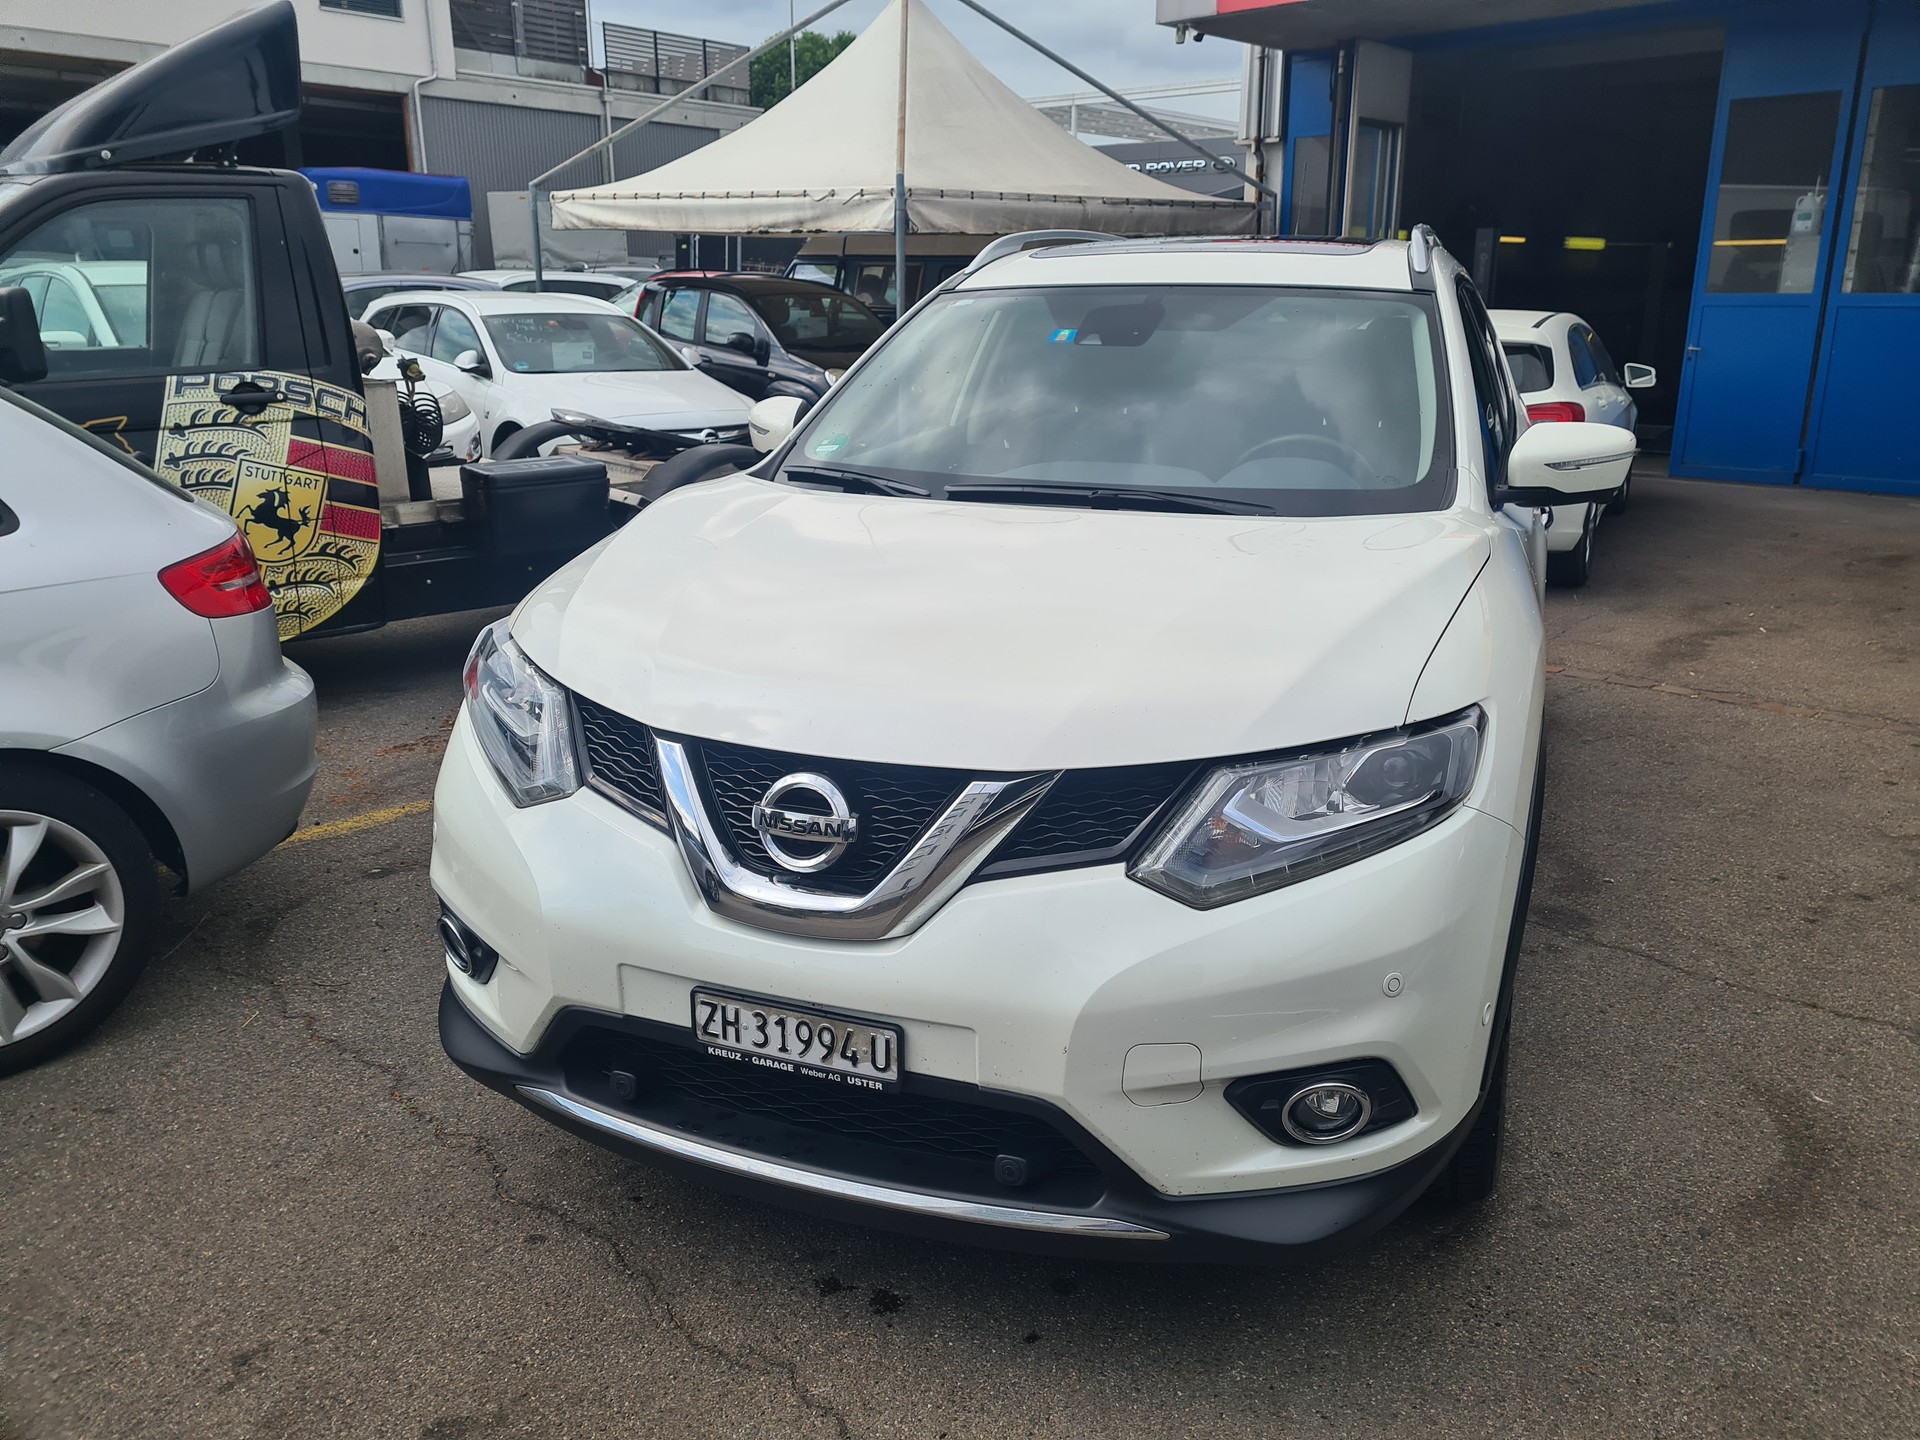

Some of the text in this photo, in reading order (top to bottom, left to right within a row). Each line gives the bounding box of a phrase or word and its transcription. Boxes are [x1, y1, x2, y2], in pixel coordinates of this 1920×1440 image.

[1146, 160, 1206, 173] ROVER
[244, 465, 321, 491] STUTTGART
[759, 810, 842, 837] NISSAN
[707, 1046, 742, 1061] KREUZ
[751, 1056, 794, 1072] GARAGE
[800, 1066, 827, 1080] Weber
[828, 1071, 841, 1082] AG
[847, 1076, 883, 1091] USTER
